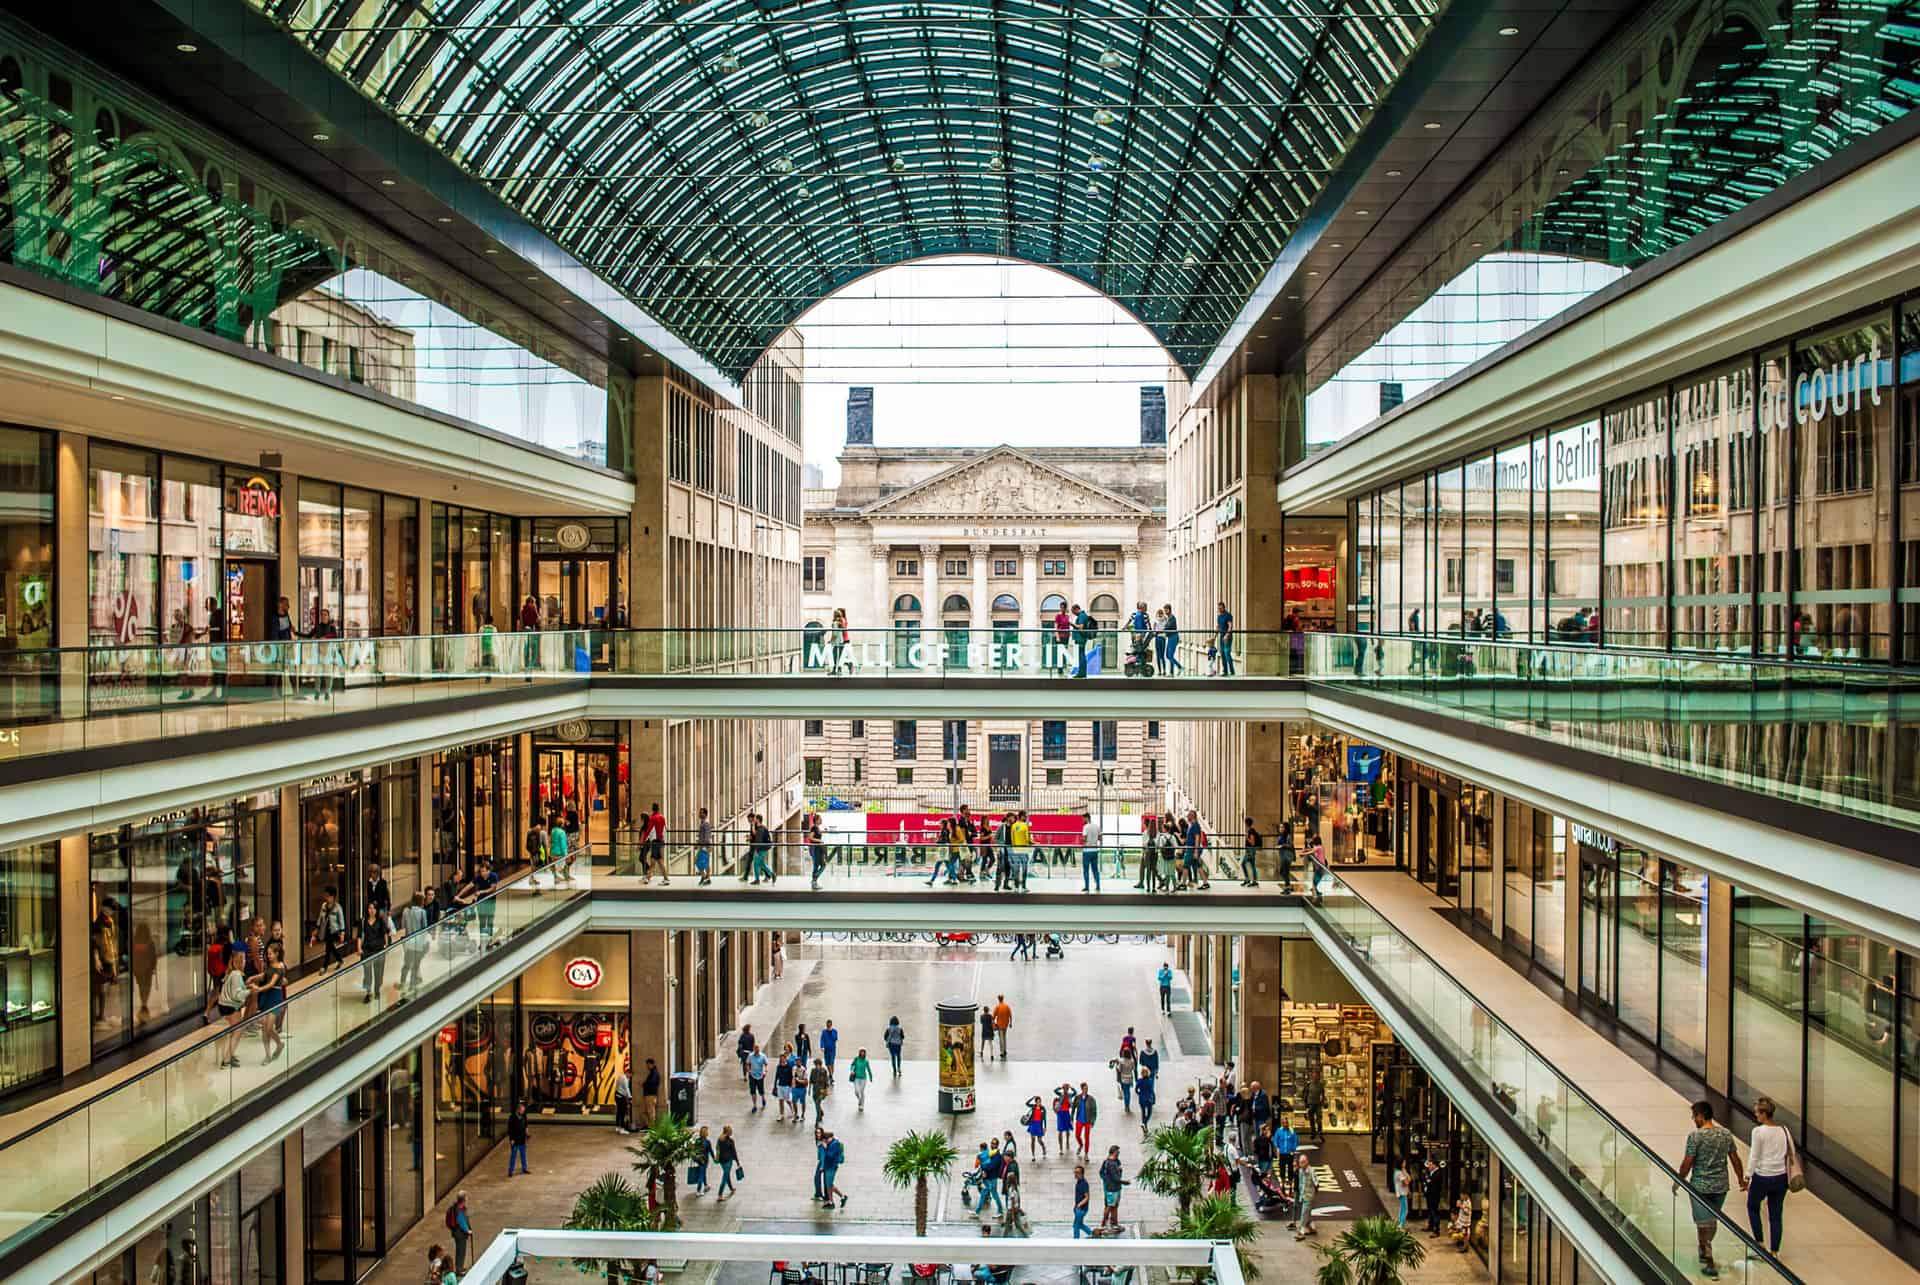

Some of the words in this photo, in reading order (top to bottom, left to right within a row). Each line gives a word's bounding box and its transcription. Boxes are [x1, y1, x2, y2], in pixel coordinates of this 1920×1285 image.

[1474, 460, 1529, 491] Weome
[1556, 427, 1601, 485] Berlin
[240, 487, 278, 519] RENO
[963, 527, 1047, 537] BUNDESRAT
[808, 643, 893, 668] MALL
[907, 643, 950, 668] OF
[967, 643, 1080, 668] BERLIN
[571, 967, 593, 982] C&A
